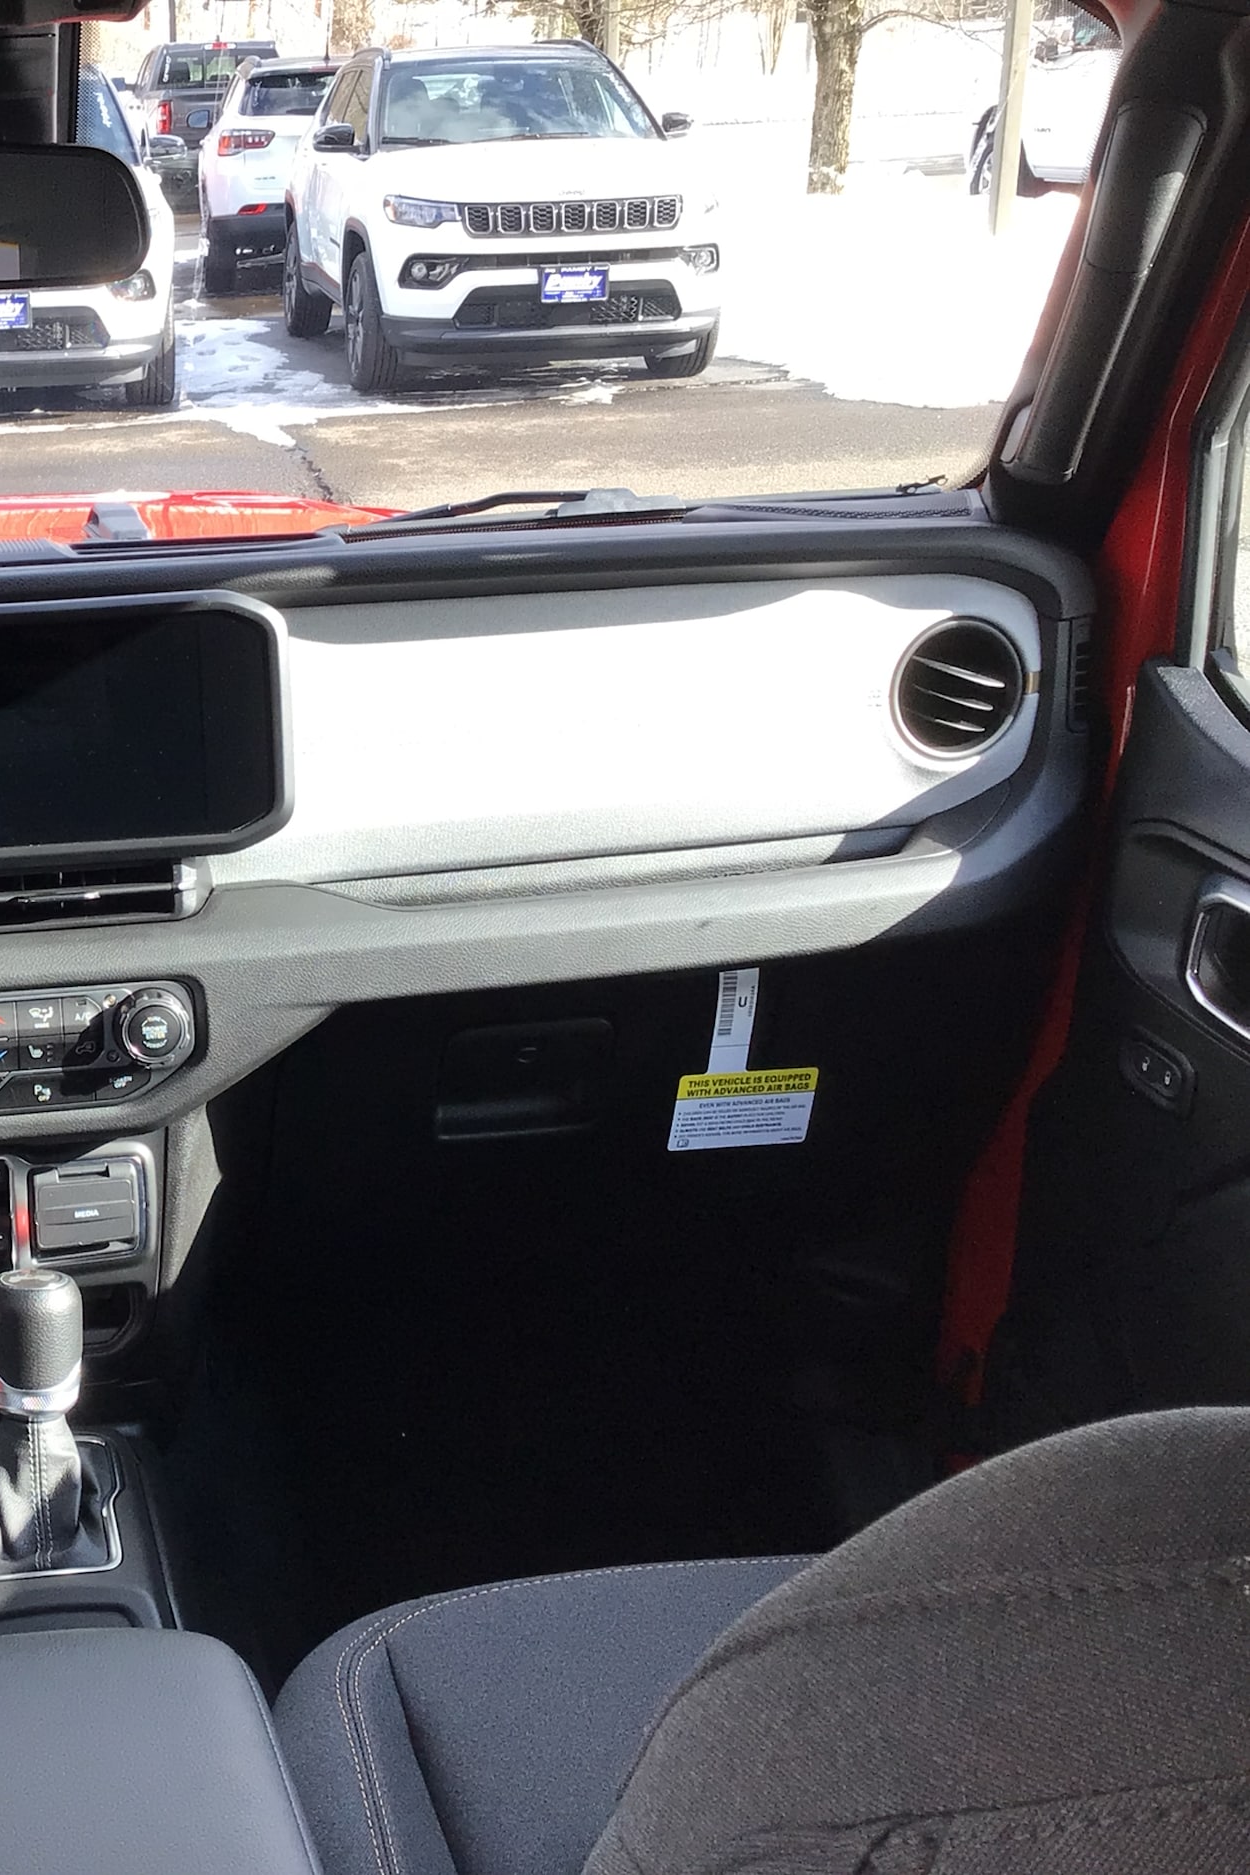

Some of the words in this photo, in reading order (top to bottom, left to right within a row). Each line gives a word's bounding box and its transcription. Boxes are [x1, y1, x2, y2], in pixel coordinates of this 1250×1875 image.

[738, 996, 748, 1007] U
[688, 1080, 710, 1088] THIS
[712, 1078, 752, 1087] VEHICLE
[753, 1076, 763, 1084] IS
[764, 1073, 811, 1083] EQUIPPED
[34, 1084, 43, 1095] P
[687, 1088, 711, 1097] WITH
[714, 1085, 765, 1095] ADVANCED
[785, 1082, 810, 1090] BAGS
[732, 1098, 763, 1106] ADVANCED
[74, 1208, 99, 1218] MEDIA
